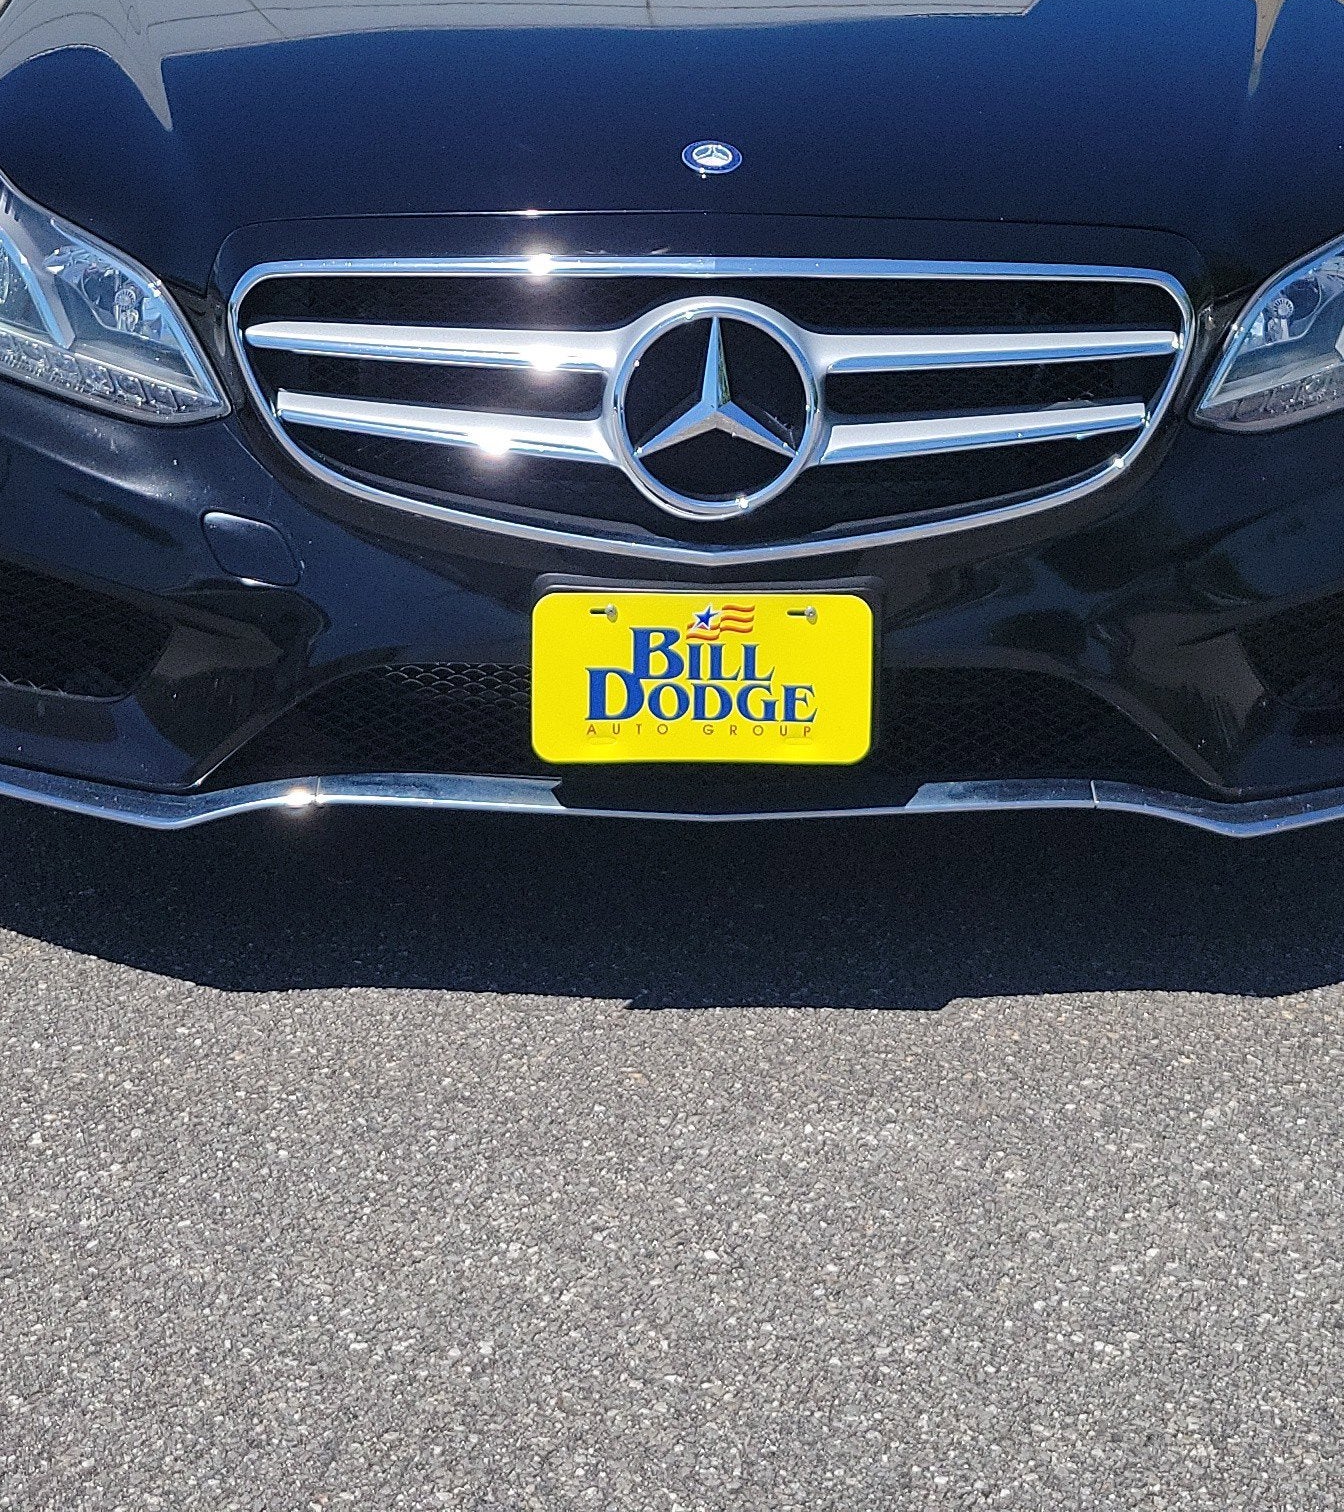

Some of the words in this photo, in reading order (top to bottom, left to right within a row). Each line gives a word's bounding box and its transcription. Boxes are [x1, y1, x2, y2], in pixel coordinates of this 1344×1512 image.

[629, 626, 775, 682] BILL
[584, 666, 818, 723] DODGE
[586, 722, 669, 736] AUTO
[702, 723, 813, 737] GROUP
